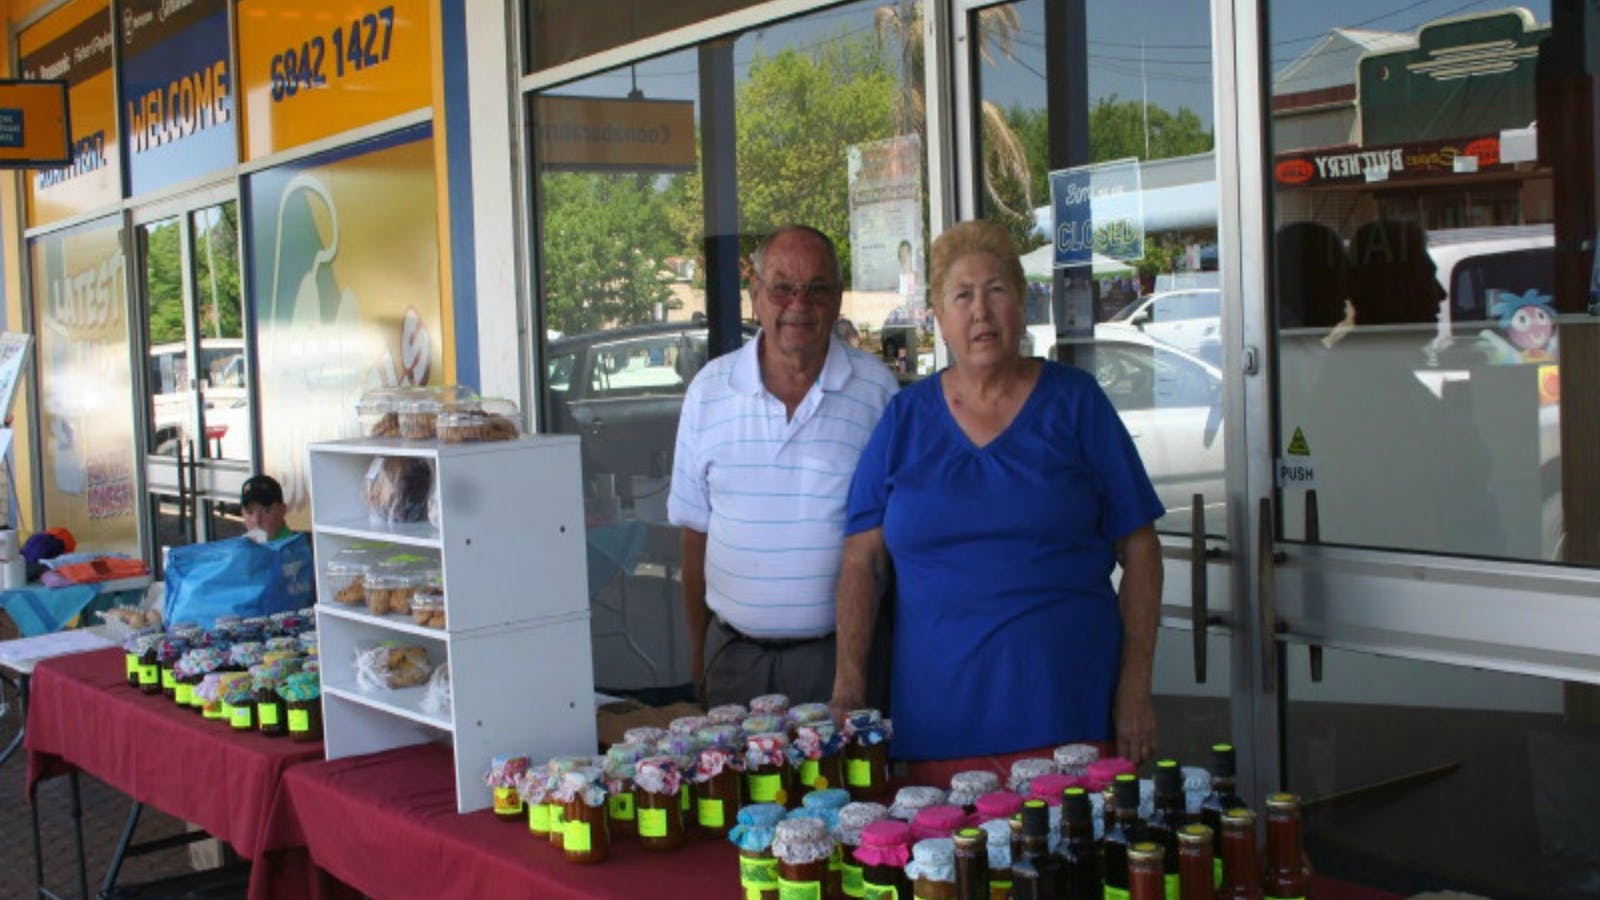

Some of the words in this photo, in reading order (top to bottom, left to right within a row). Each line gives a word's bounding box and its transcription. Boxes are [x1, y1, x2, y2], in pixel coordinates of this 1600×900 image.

[270, 35, 326, 103] 6842
[332, 5, 394, 78] 1427
[128, 60, 231, 154] WELCOME
[1058, 218, 1139, 254] CLOSED
[53, 254, 123, 327] LATEST
[1280, 466, 1314, 481] PUSH
